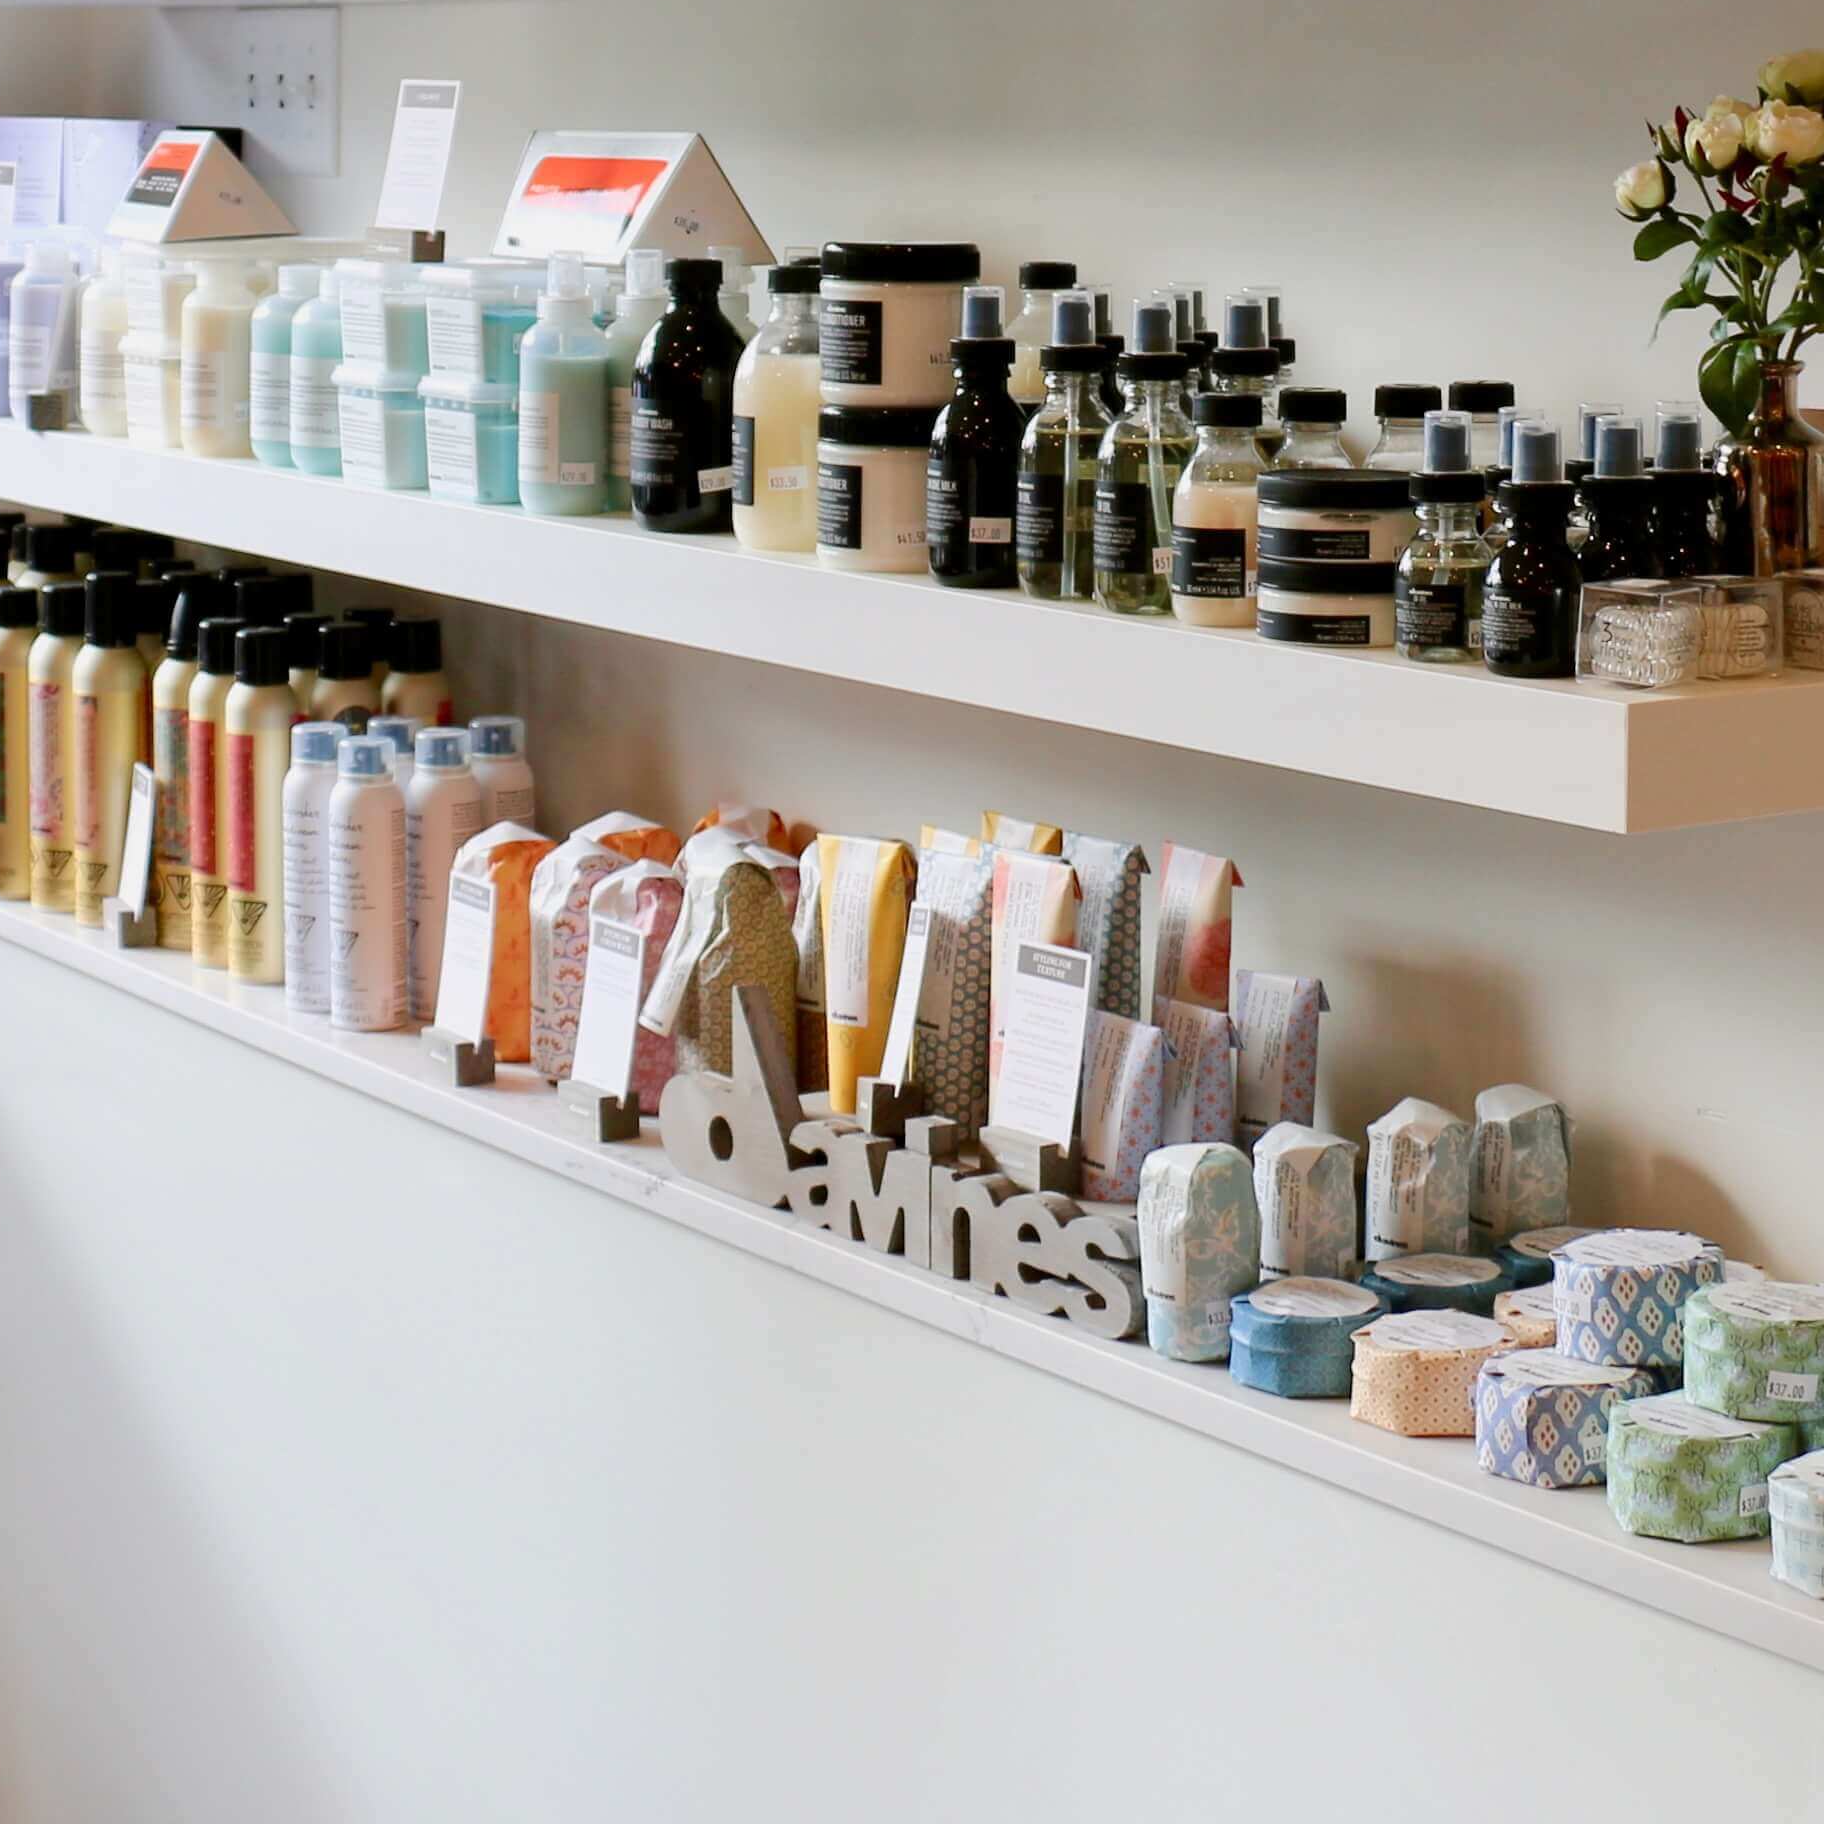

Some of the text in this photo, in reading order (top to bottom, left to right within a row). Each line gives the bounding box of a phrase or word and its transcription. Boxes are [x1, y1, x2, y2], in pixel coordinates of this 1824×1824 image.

[1602, 622, 1614, 643] 3
[1599, 643, 1633, 661] rings
[1769, 1380, 1806, 1399] $37.00
